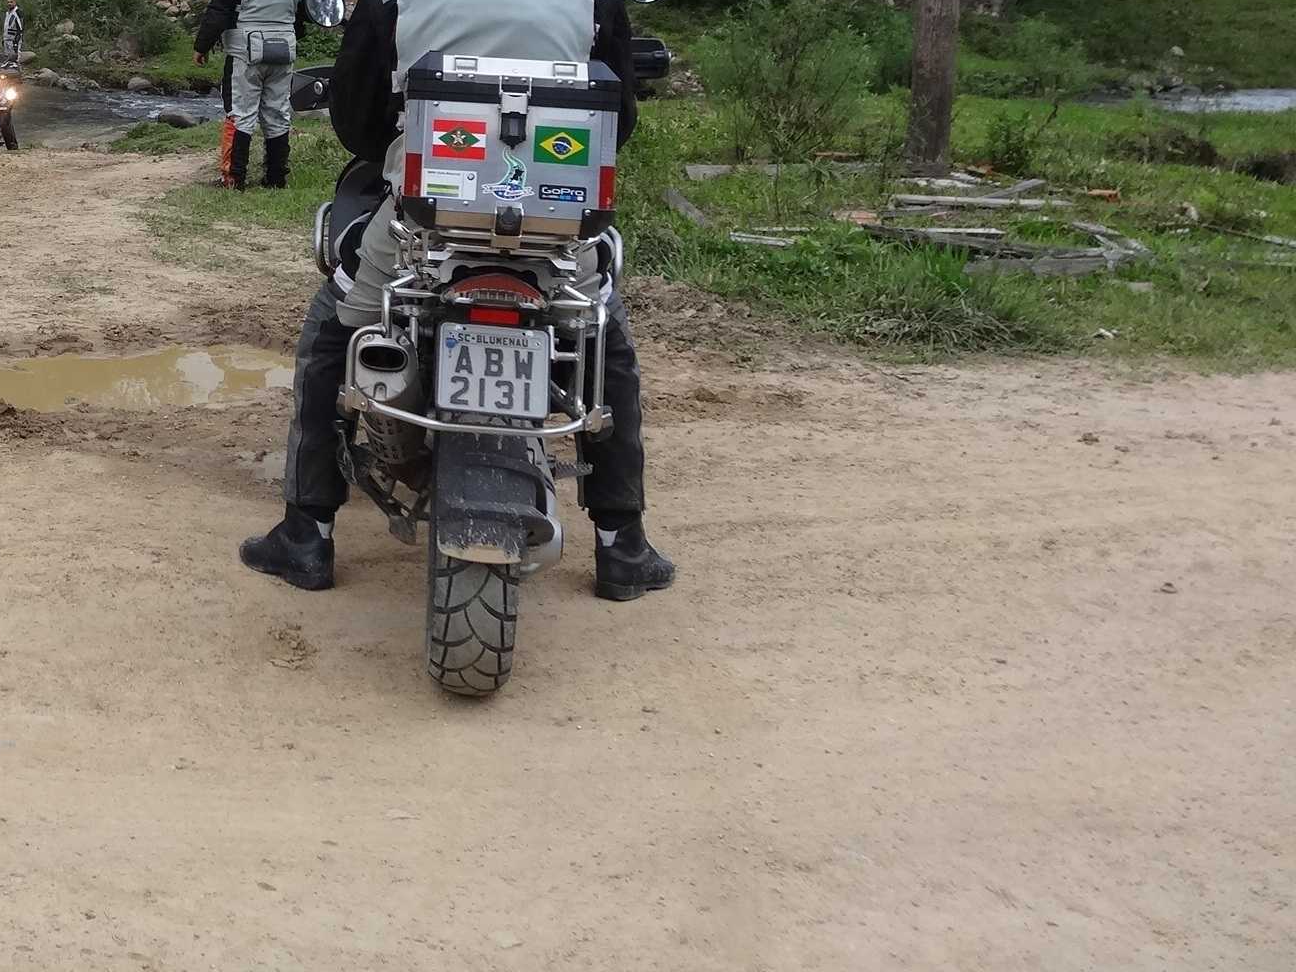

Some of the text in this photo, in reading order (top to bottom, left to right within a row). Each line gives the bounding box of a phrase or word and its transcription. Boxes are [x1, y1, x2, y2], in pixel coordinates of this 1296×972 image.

[541, 186, 584, 196] GoPro
[454, 345, 534, 380] ABW
[450, 375, 531, 411] 2131
